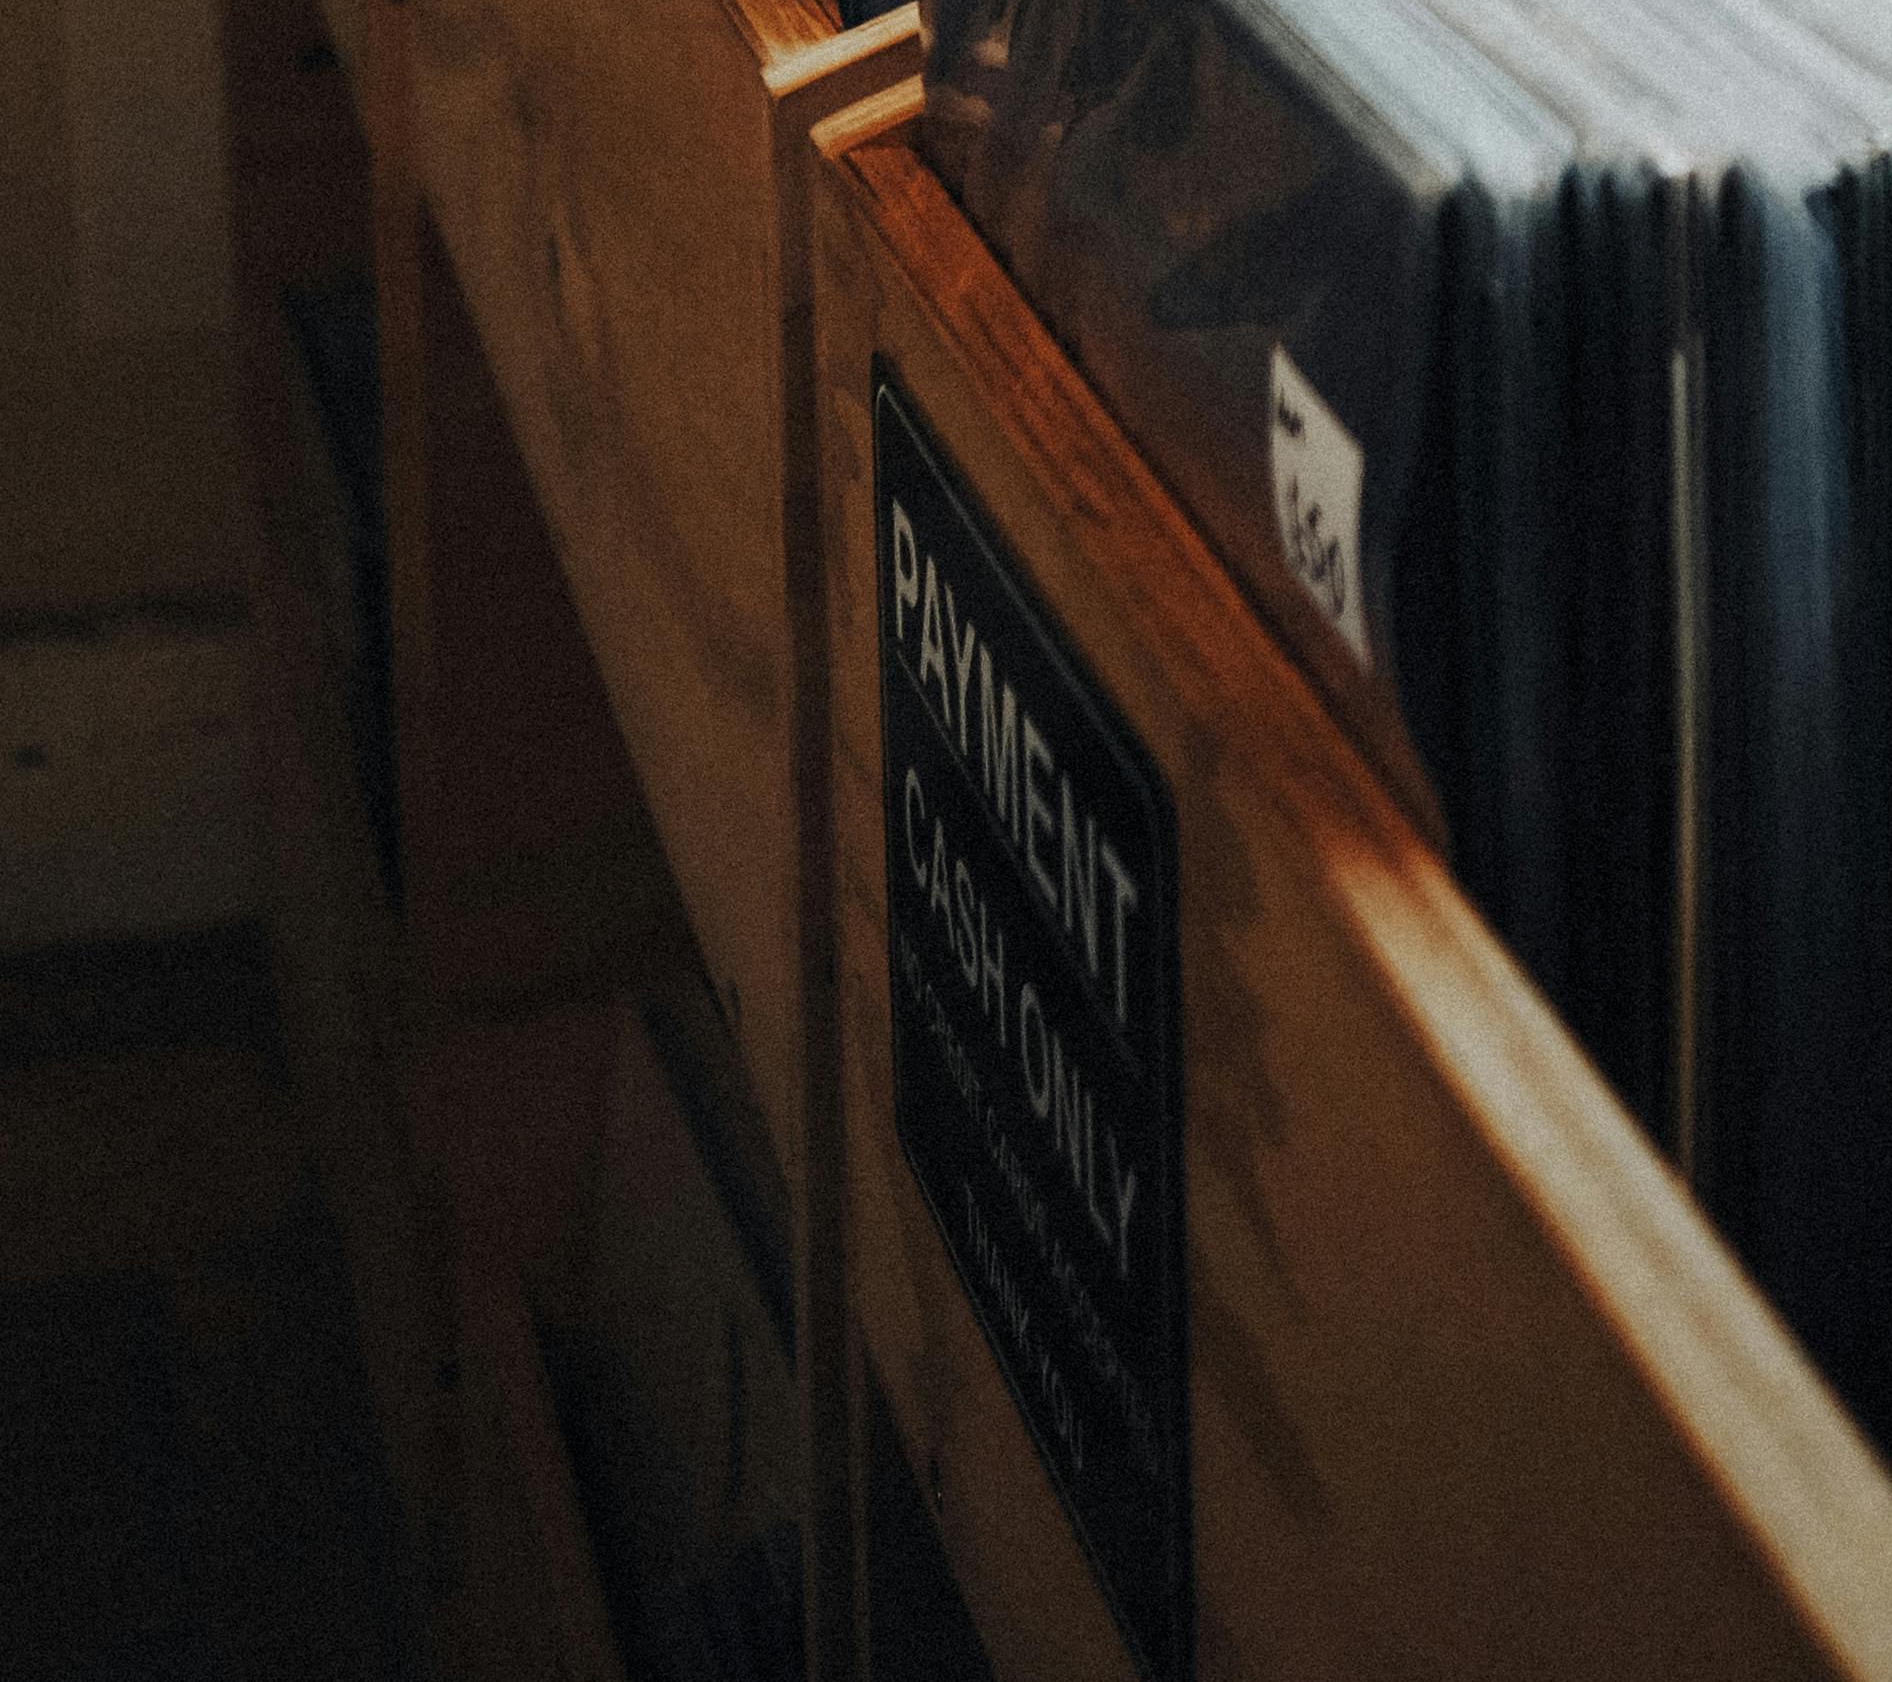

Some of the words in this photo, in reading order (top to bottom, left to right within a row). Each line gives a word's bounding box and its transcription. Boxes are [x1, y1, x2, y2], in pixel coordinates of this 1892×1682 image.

[893, 495, 1137, 1026] PAYMENT
[905, 755, 1005, 1050] CASH
[1020, 969, 1137, 1278] ONLY
[1037, 1332, 1083, 1470] YOU
